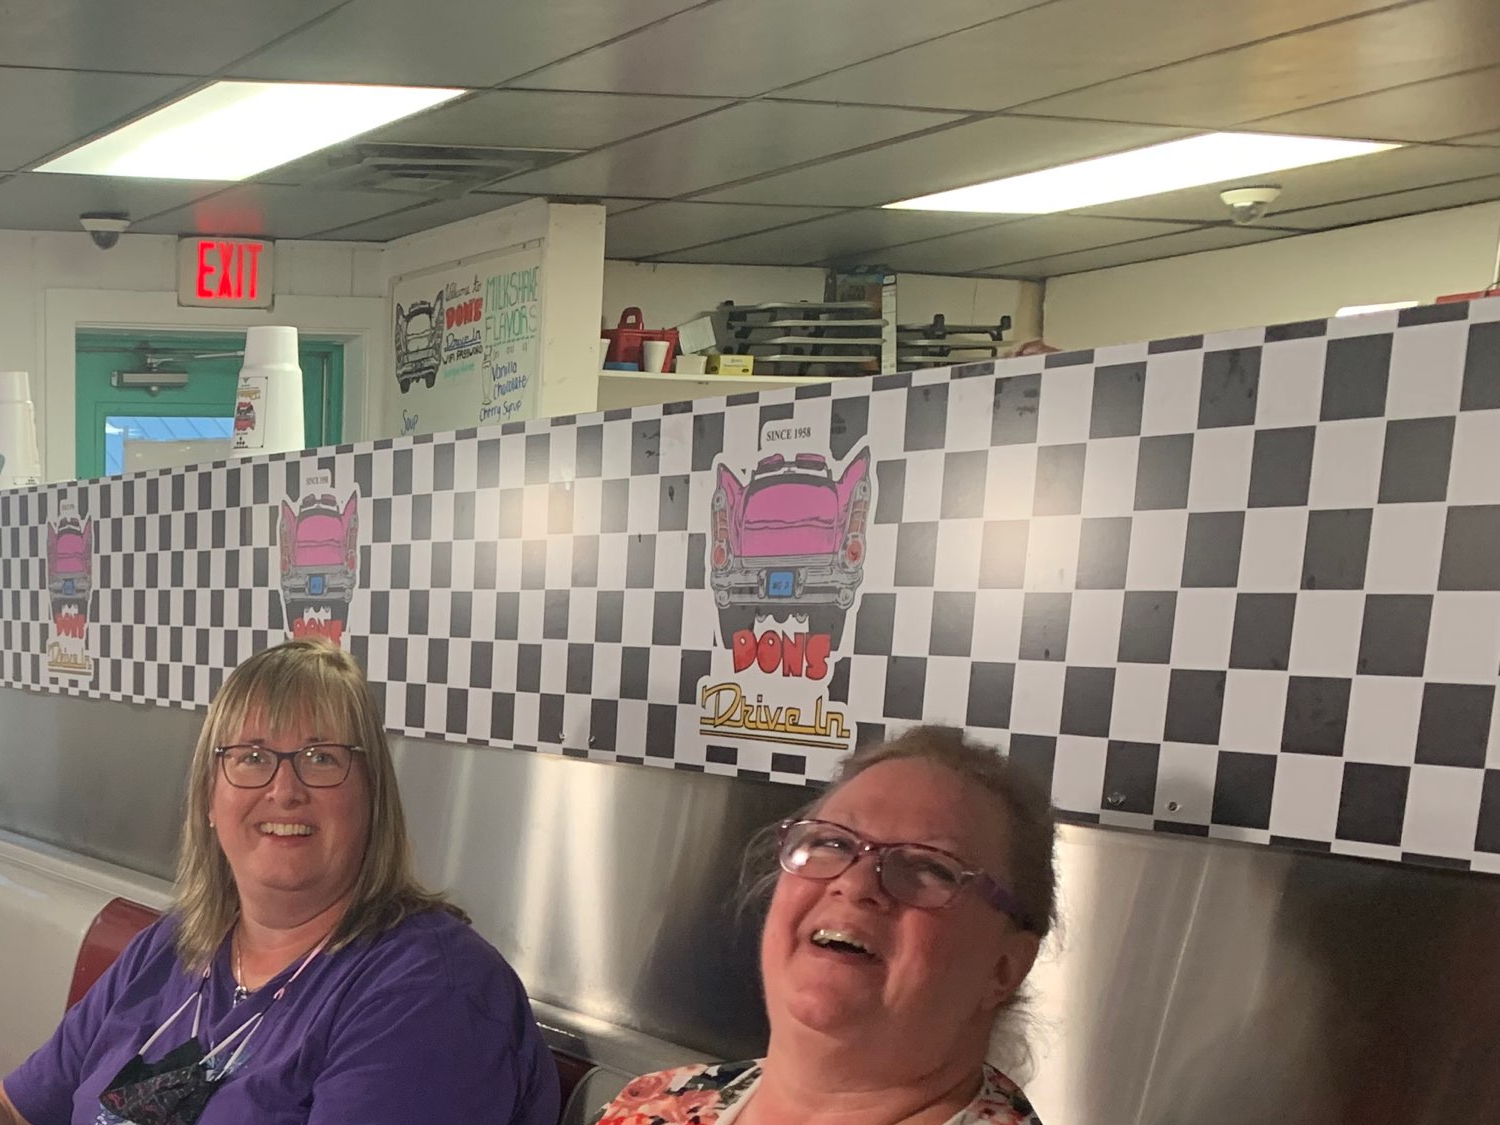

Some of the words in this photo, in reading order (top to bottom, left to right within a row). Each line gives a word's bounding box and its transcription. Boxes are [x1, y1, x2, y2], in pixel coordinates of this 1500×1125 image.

[196, 240, 263, 299] EXIT
[485, 266, 540, 314] MILKSHAKE
[485, 305, 538, 343] FLAVORS
[491, 361, 518, 383] Vanilla
[493, 374, 528, 401] Chocolate
[401, 408, 419, 437] Soup
[766, 428, 793, 442] SINCE
[794, 426, 812, 440] 1958
[700, 682, 803, 735] Drive
[803, 696, 851, 738] In
